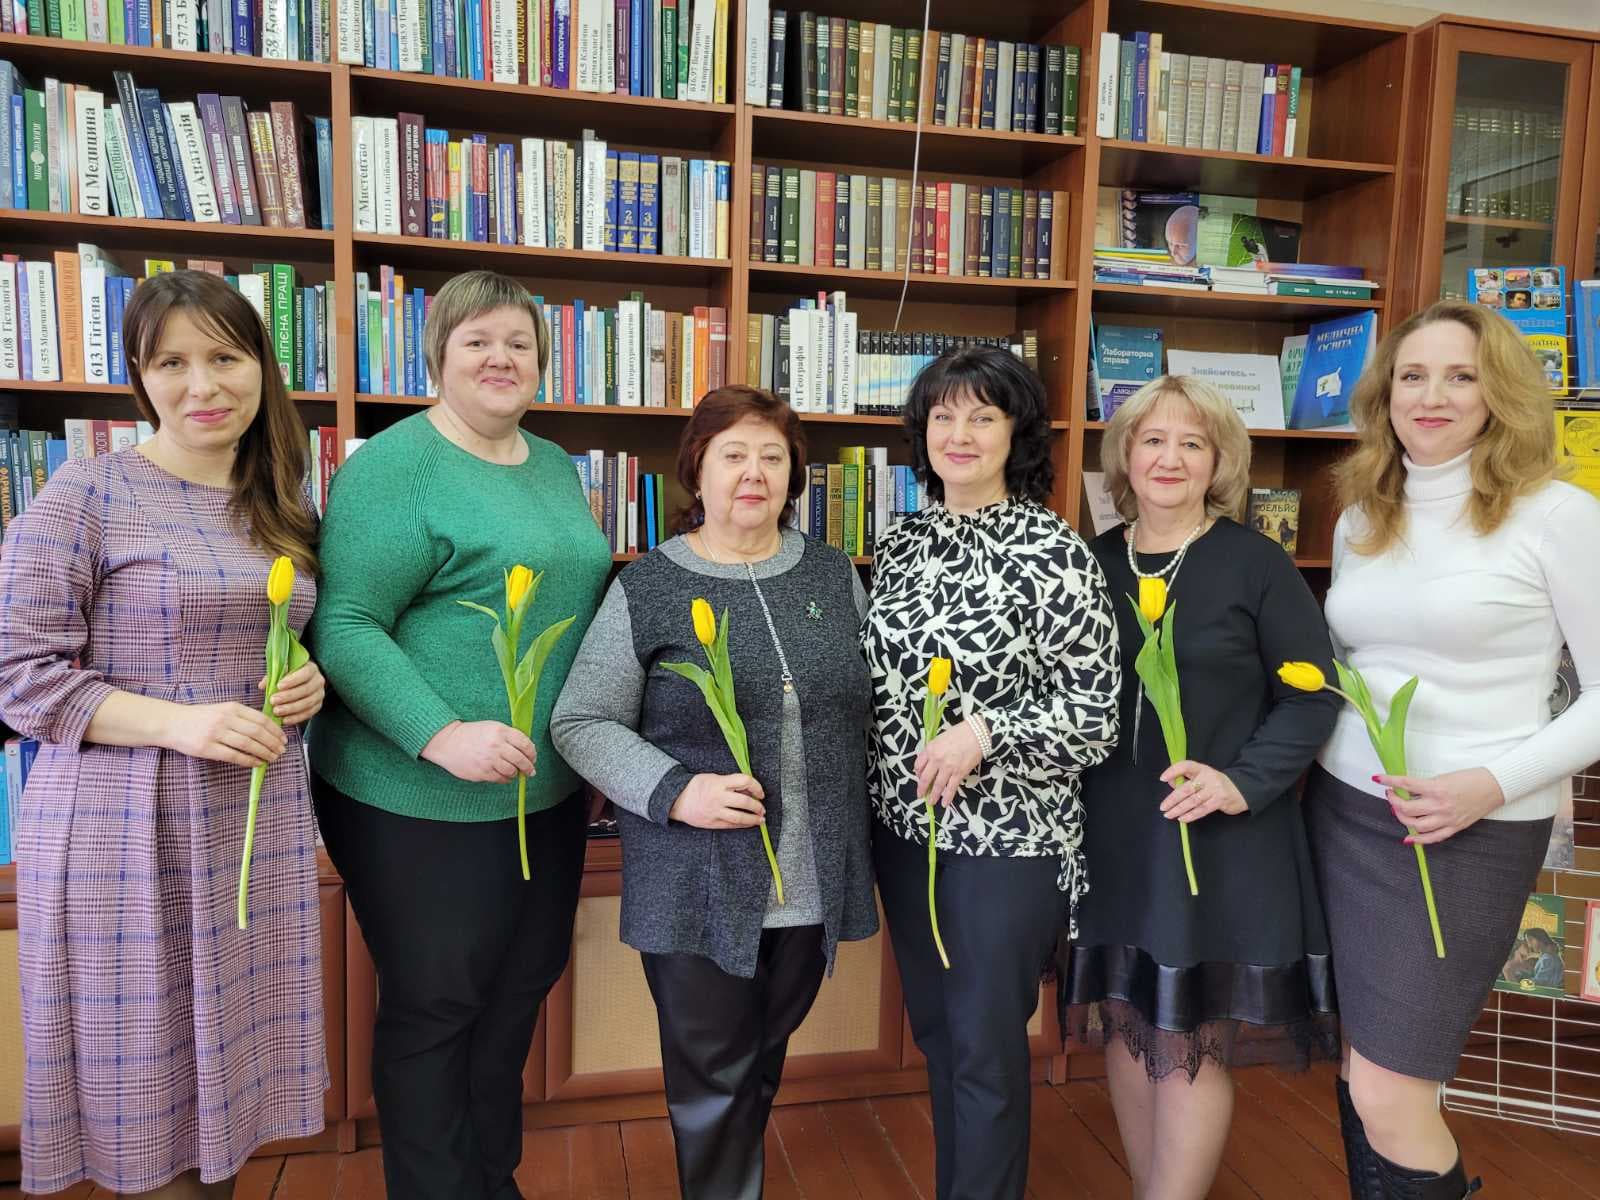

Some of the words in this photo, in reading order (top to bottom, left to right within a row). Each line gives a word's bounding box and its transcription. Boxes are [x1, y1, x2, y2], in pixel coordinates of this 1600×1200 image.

[177, 14, 190, 46] 577.3
[84, 107, 99, 189] Медицина
[179, 114, 206, 187] Анатомія
[359, 143, 370, 212] Мистецтво
[85, 196, 101, 211] 61
[197, 193, 215, 217] 611
[1, 279, 13, 332] Гістологія
[277, 272, 288, 310] ПРАЦІ
[39, 309, 48, 346] Медична
[88, 295, 102, 347] Гігієна
[279, 313, 290, 359] ГІГІЄНА
[1317, 325, 1364, 342] МЕДИЧНА
[3, 337, 14, 369] 611.08
[1103, 348, 1154, 359] Лабораторна
[1318, 339, 1352, 352] ОСВІТА
[90, 352, 104, 377] 613
[795, 345, 807, 394] Географія
[0, 466, 12, 528] ФАРМАКОЛОГ
